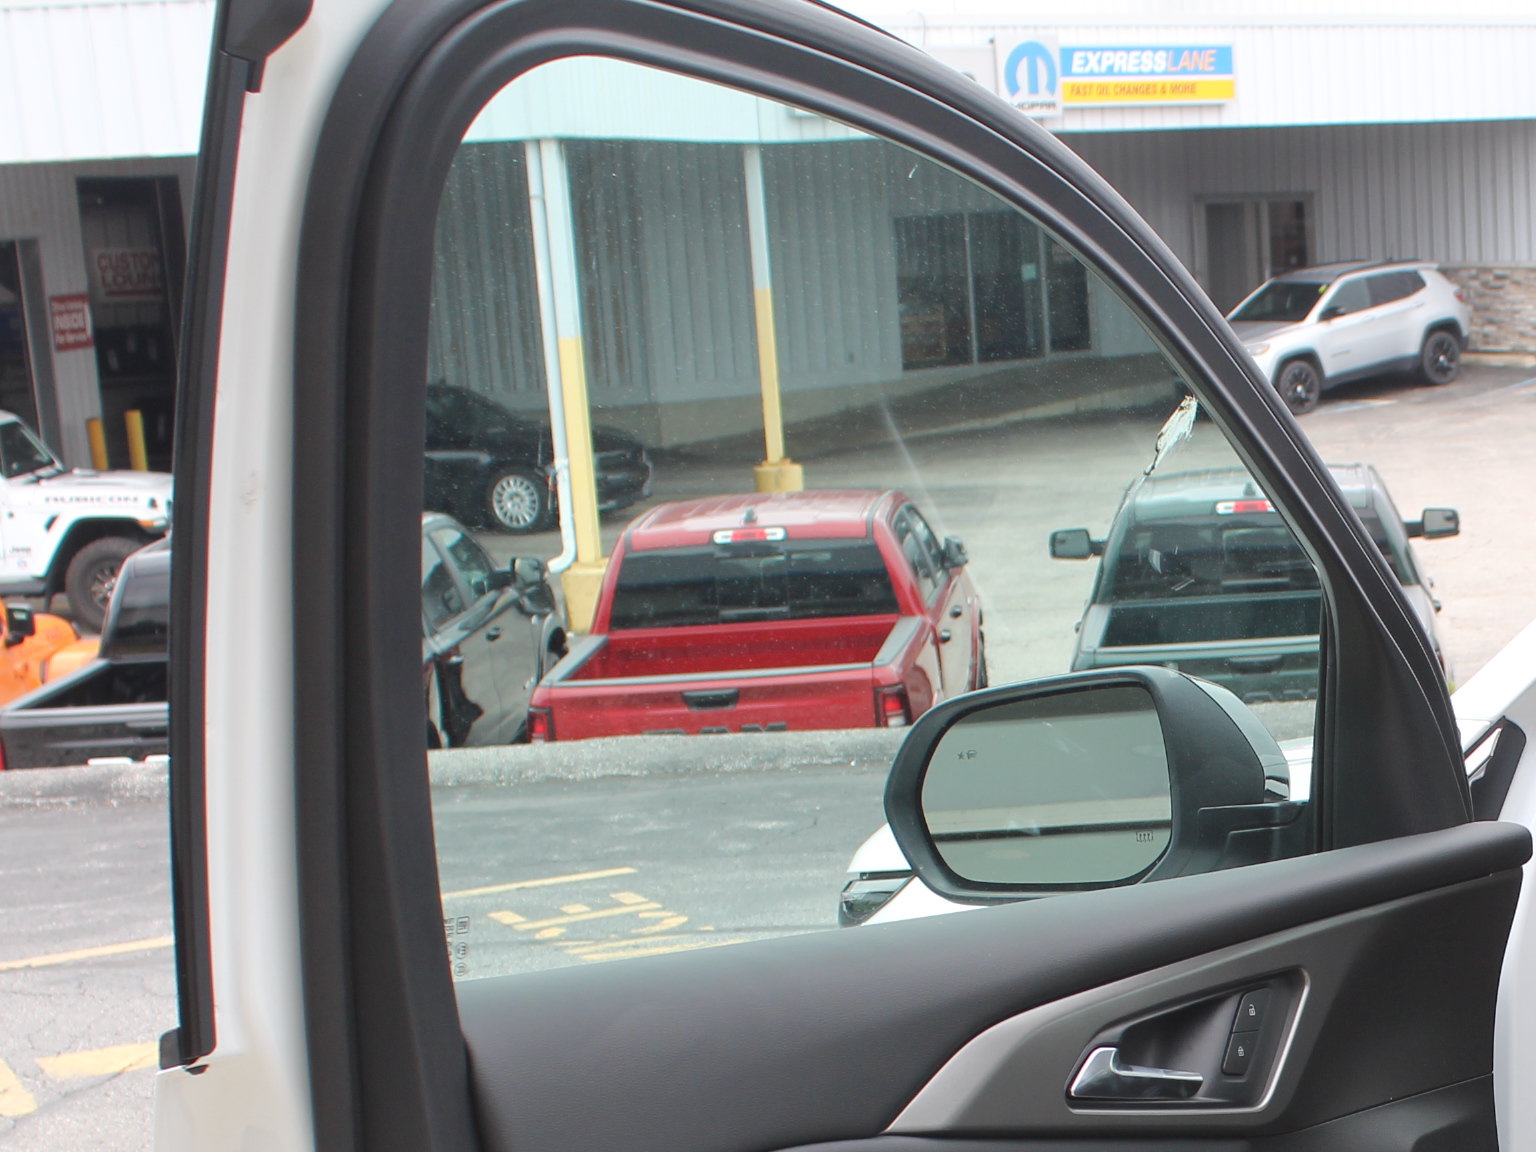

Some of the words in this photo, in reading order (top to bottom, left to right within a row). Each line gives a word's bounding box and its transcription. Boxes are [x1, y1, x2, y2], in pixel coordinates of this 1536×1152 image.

[1070, 84, 1094, 97] FAST
[1096, 84, 1111, 96] OIL
[1113, 83, 1158, 96] CHANGES
[1170, 82, 1197, 95] MORE
[45, 496, 139, 504] RUBICON
